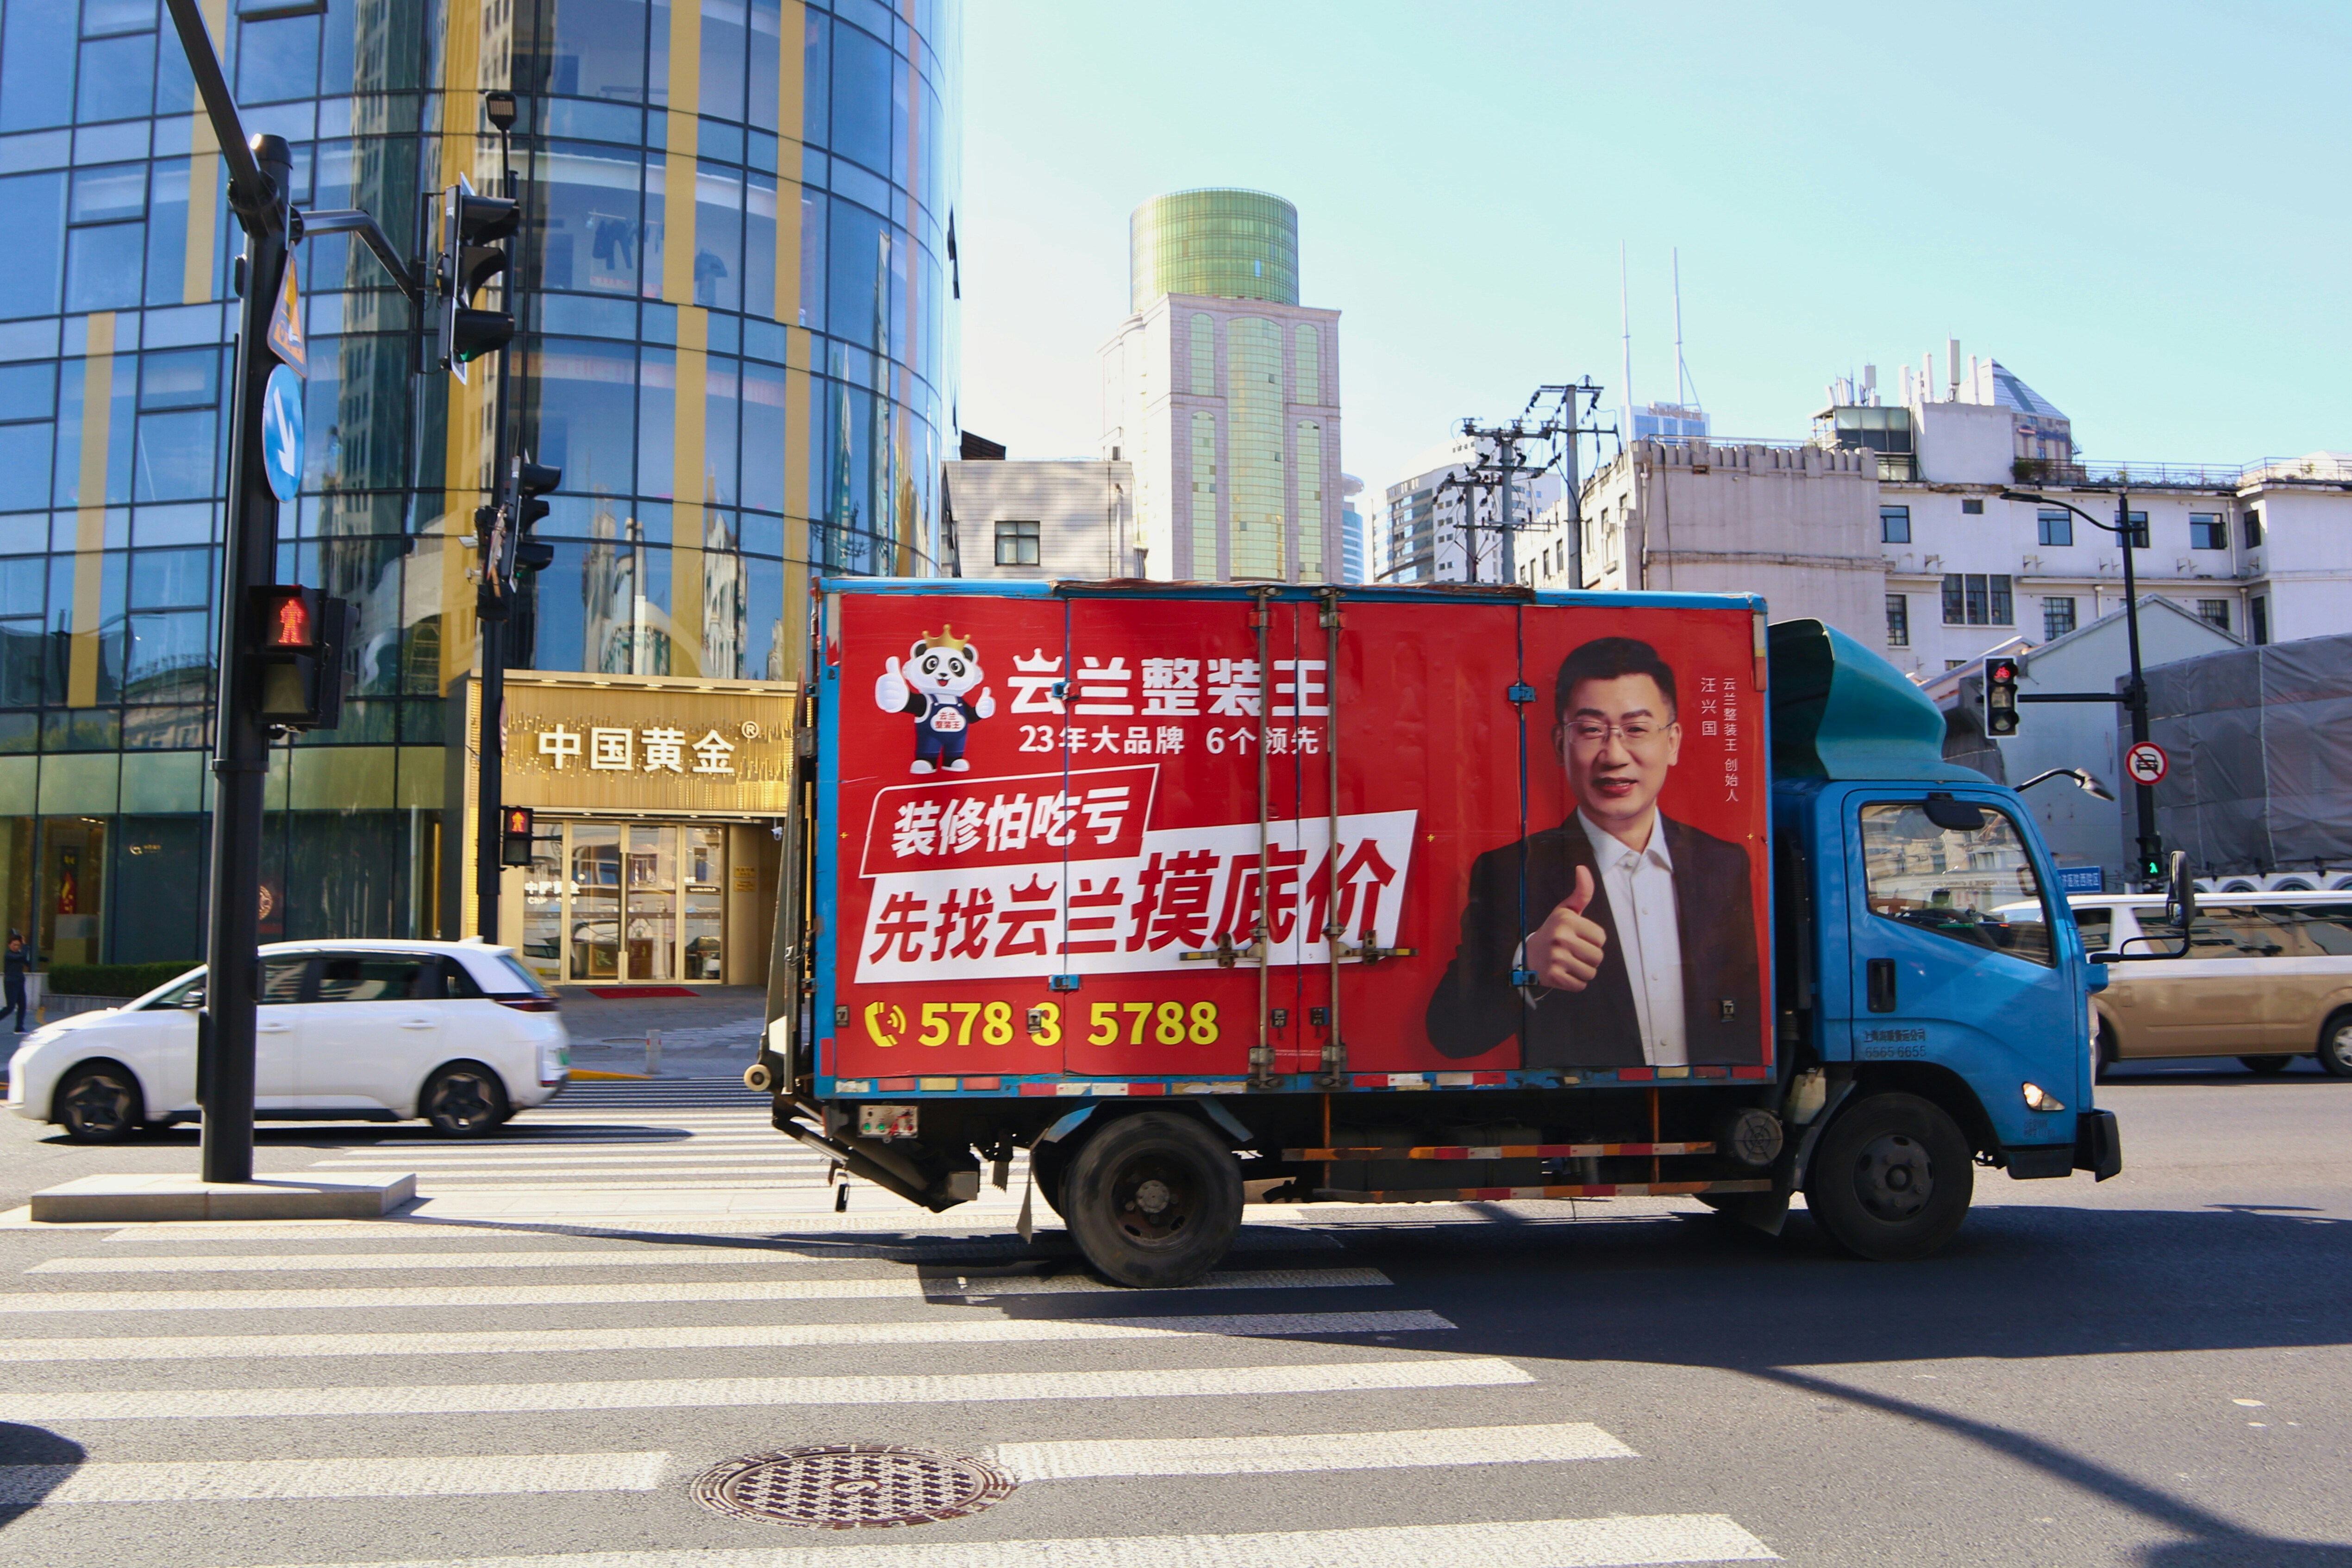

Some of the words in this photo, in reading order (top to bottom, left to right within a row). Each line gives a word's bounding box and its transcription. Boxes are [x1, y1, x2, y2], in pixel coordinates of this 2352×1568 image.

[1007, 648, 1328, 716] 云兰整装王
[1701, 677, 1717, 736] 汪兴国
[1019, 725, 1185, 754] 23年大品牌
[1206, 726, 1320, 755] 6个领先
[1723, 678, 1738, 751] 云兰整装王
[538, 724, 735, 773] 中国黄金
[1725, 758, 1739, 801] 创始人
[891, 786, 1130, 859] 装修怕吃亏
[869, 837, 1397, 965] 先找云兰摸底价
[918, 1001, 1062, 1046] 5788
[1087, 1001, 1219, 1046] 5788
